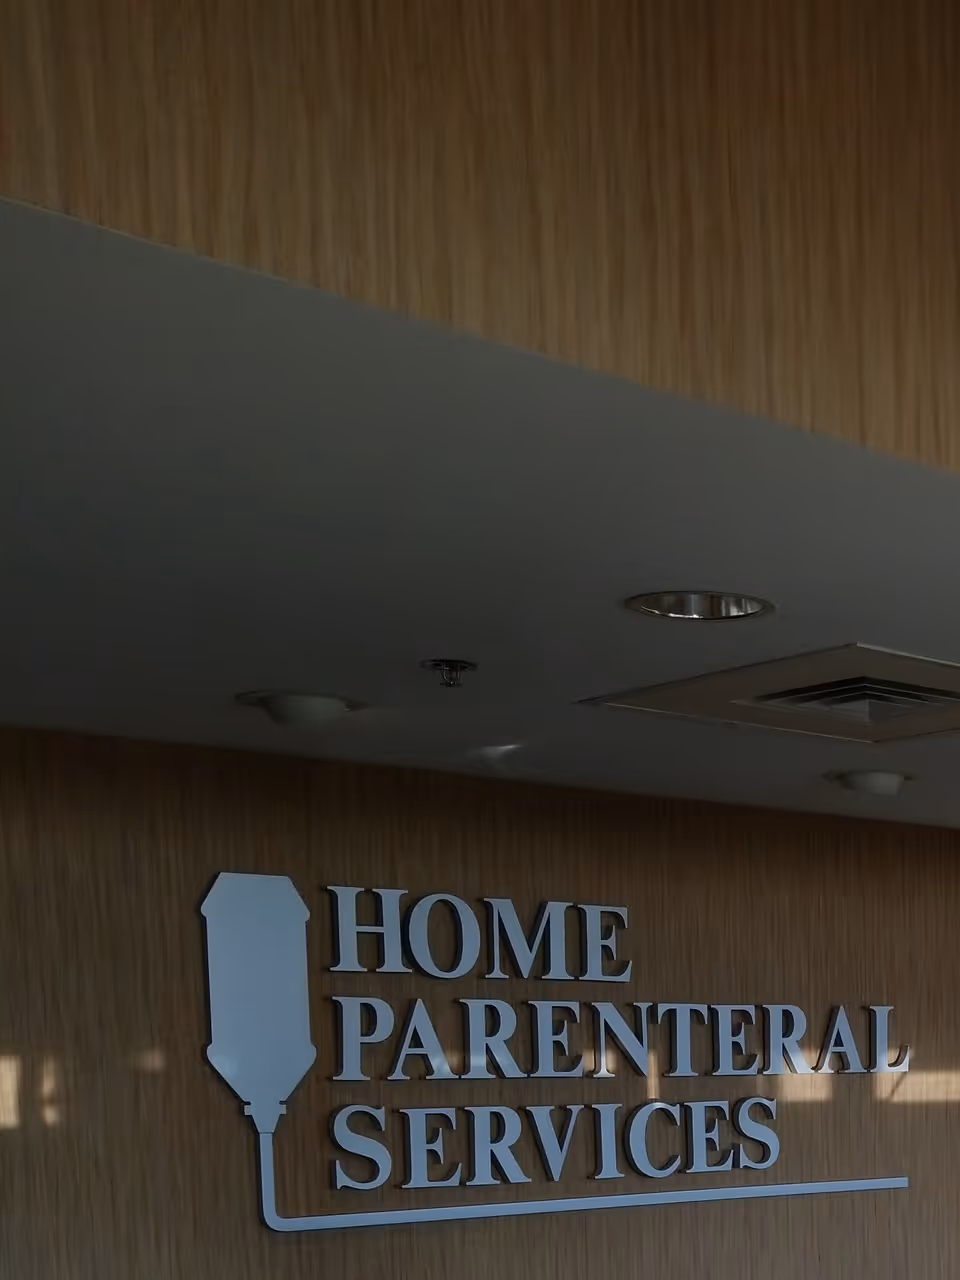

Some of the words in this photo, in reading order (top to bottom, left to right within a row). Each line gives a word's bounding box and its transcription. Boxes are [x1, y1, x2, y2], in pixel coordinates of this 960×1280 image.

[327, 885, 633, 983] HOME
[331, 996, 910, 1081] PARENTERAL
[332, 1097, 781, 1191] SERVICES
